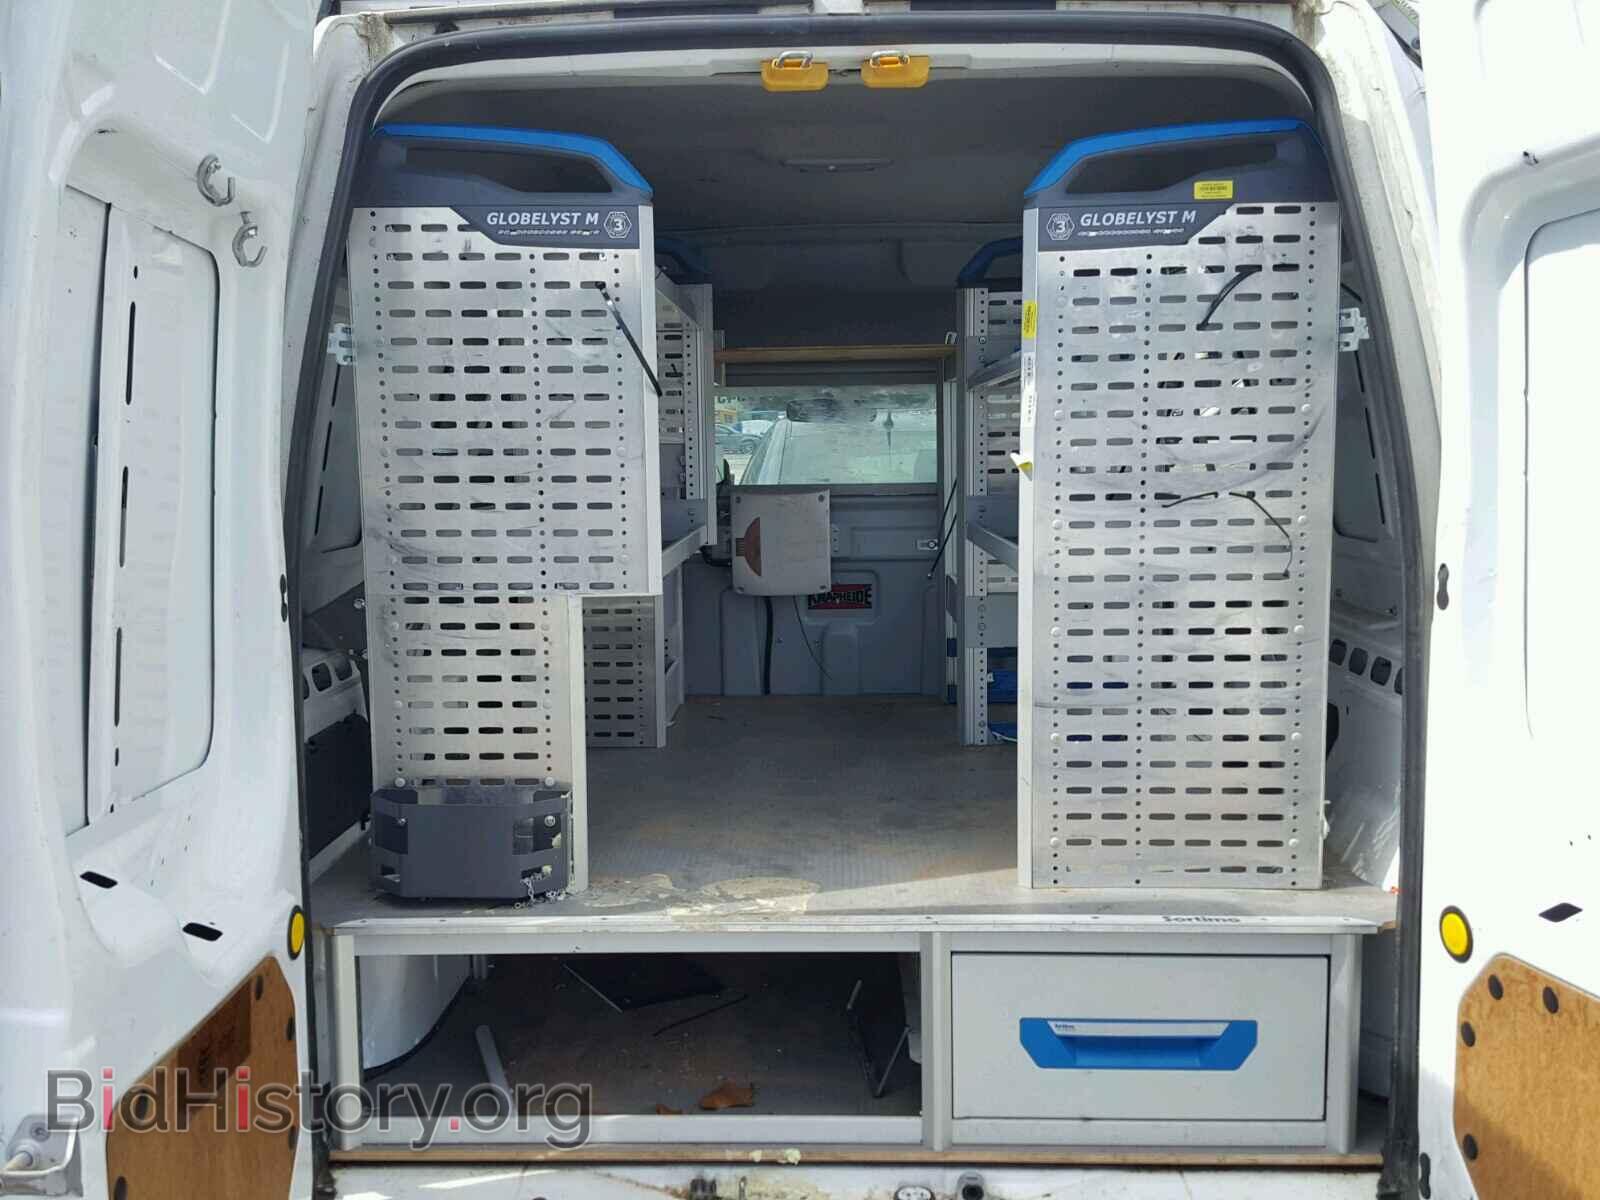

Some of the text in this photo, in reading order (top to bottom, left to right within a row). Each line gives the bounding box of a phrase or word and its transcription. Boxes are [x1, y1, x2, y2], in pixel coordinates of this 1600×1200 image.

[486, 212, 600, 225] GLOBELYST M
[1079, 209, 1197, 227] GLOBELYST M
[613, 219, 624, 231] 3
[1055, 220, 1066, 233] 3
